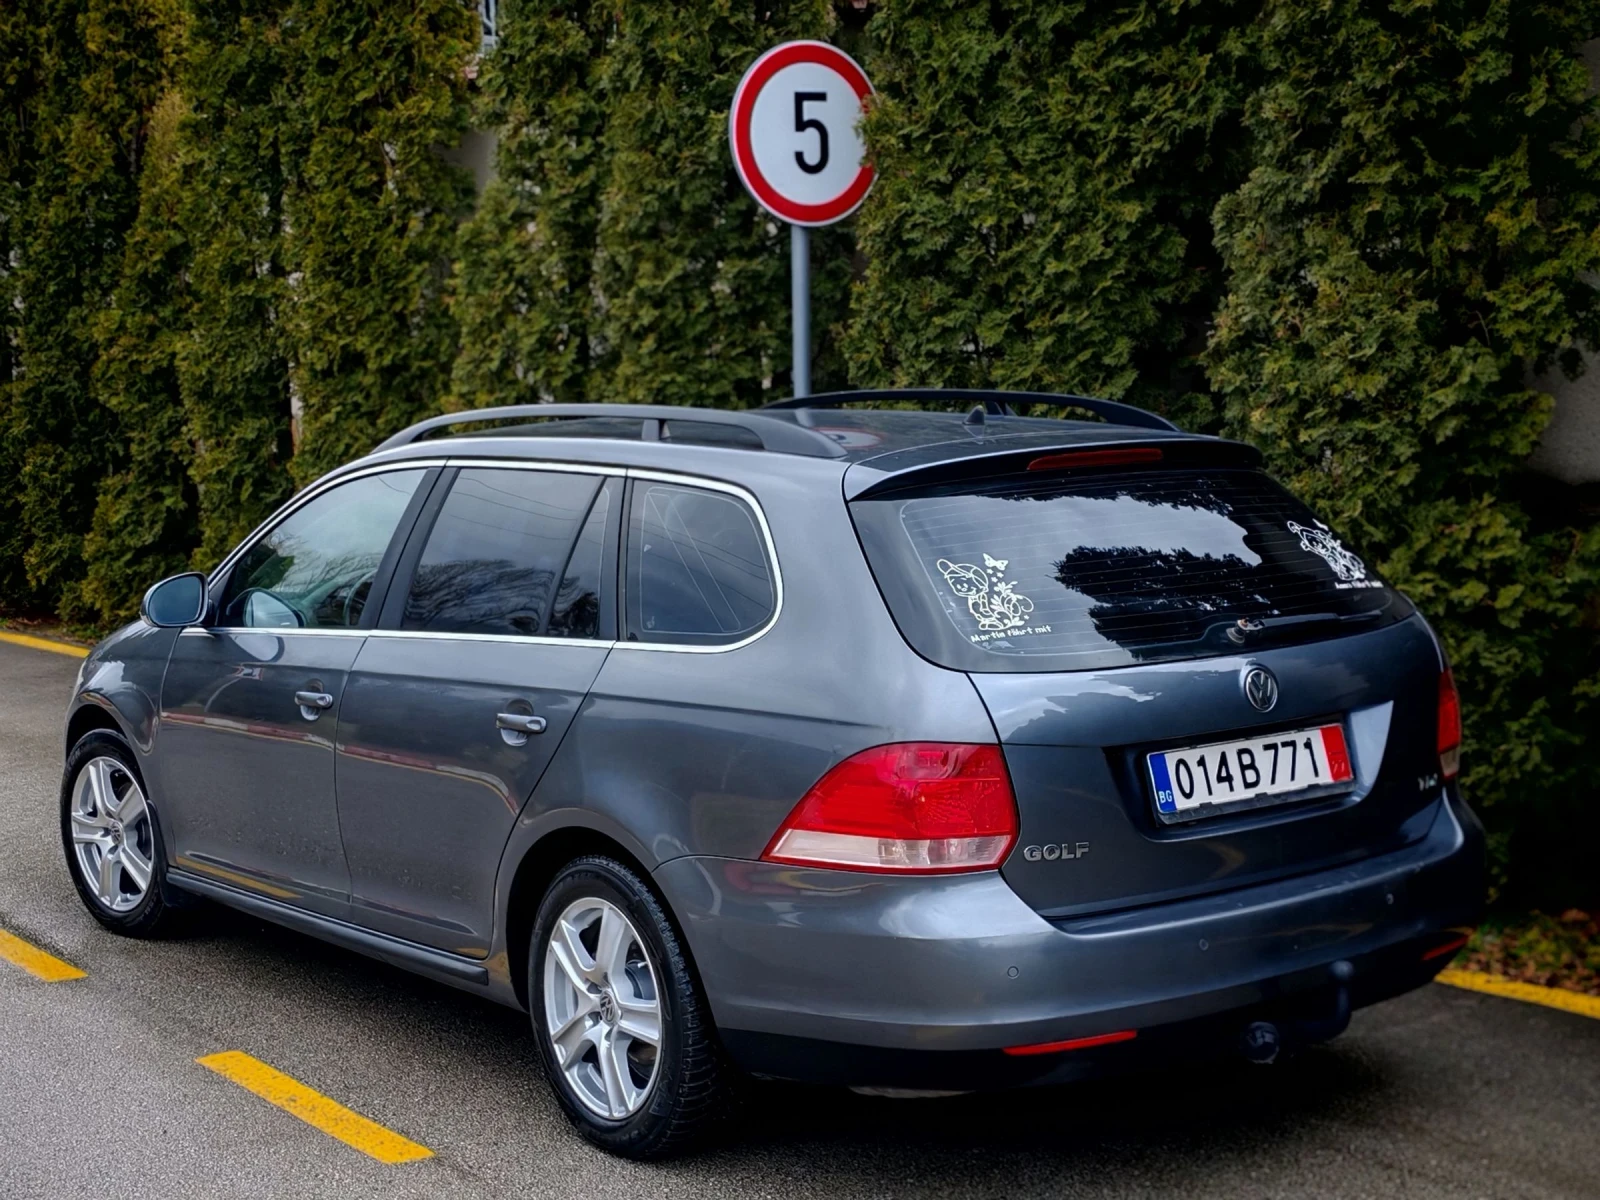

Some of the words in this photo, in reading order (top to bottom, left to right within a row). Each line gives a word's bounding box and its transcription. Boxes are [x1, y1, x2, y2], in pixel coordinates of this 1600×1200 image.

[794, 91, 829, 175] 5
[970, 631, 1006, 642] Martin
[1034, 625, 1052, 634] mit
[1158, 790, 1173, 804] BG
[1175, 737, 1319, 799] 014B771
[1023, 841, 1089, 862] GOLF
